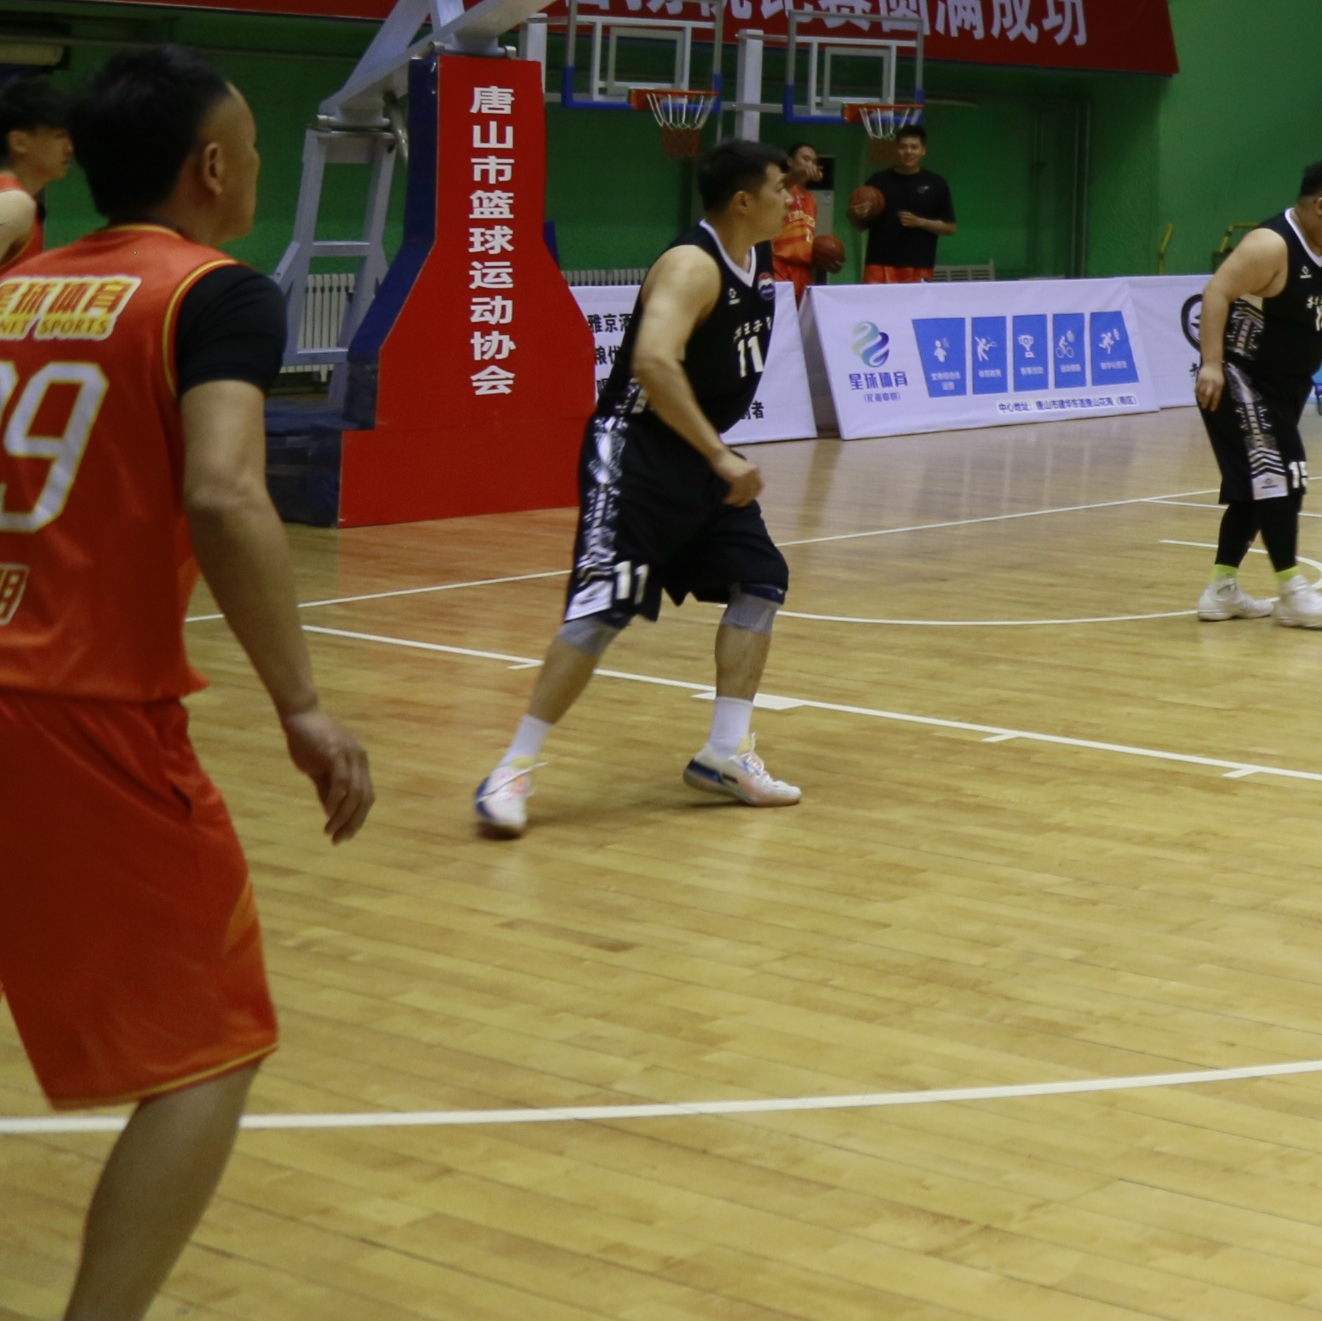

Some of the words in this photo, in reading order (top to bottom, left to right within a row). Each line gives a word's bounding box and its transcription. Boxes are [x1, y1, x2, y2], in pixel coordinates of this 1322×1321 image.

[468, 85, 516, 396] 唐山市篮球运动协会
[737, 335, 764, 378] 11
[0, 360, 111, 535] 9
[614, 561, 649, 605] 11
